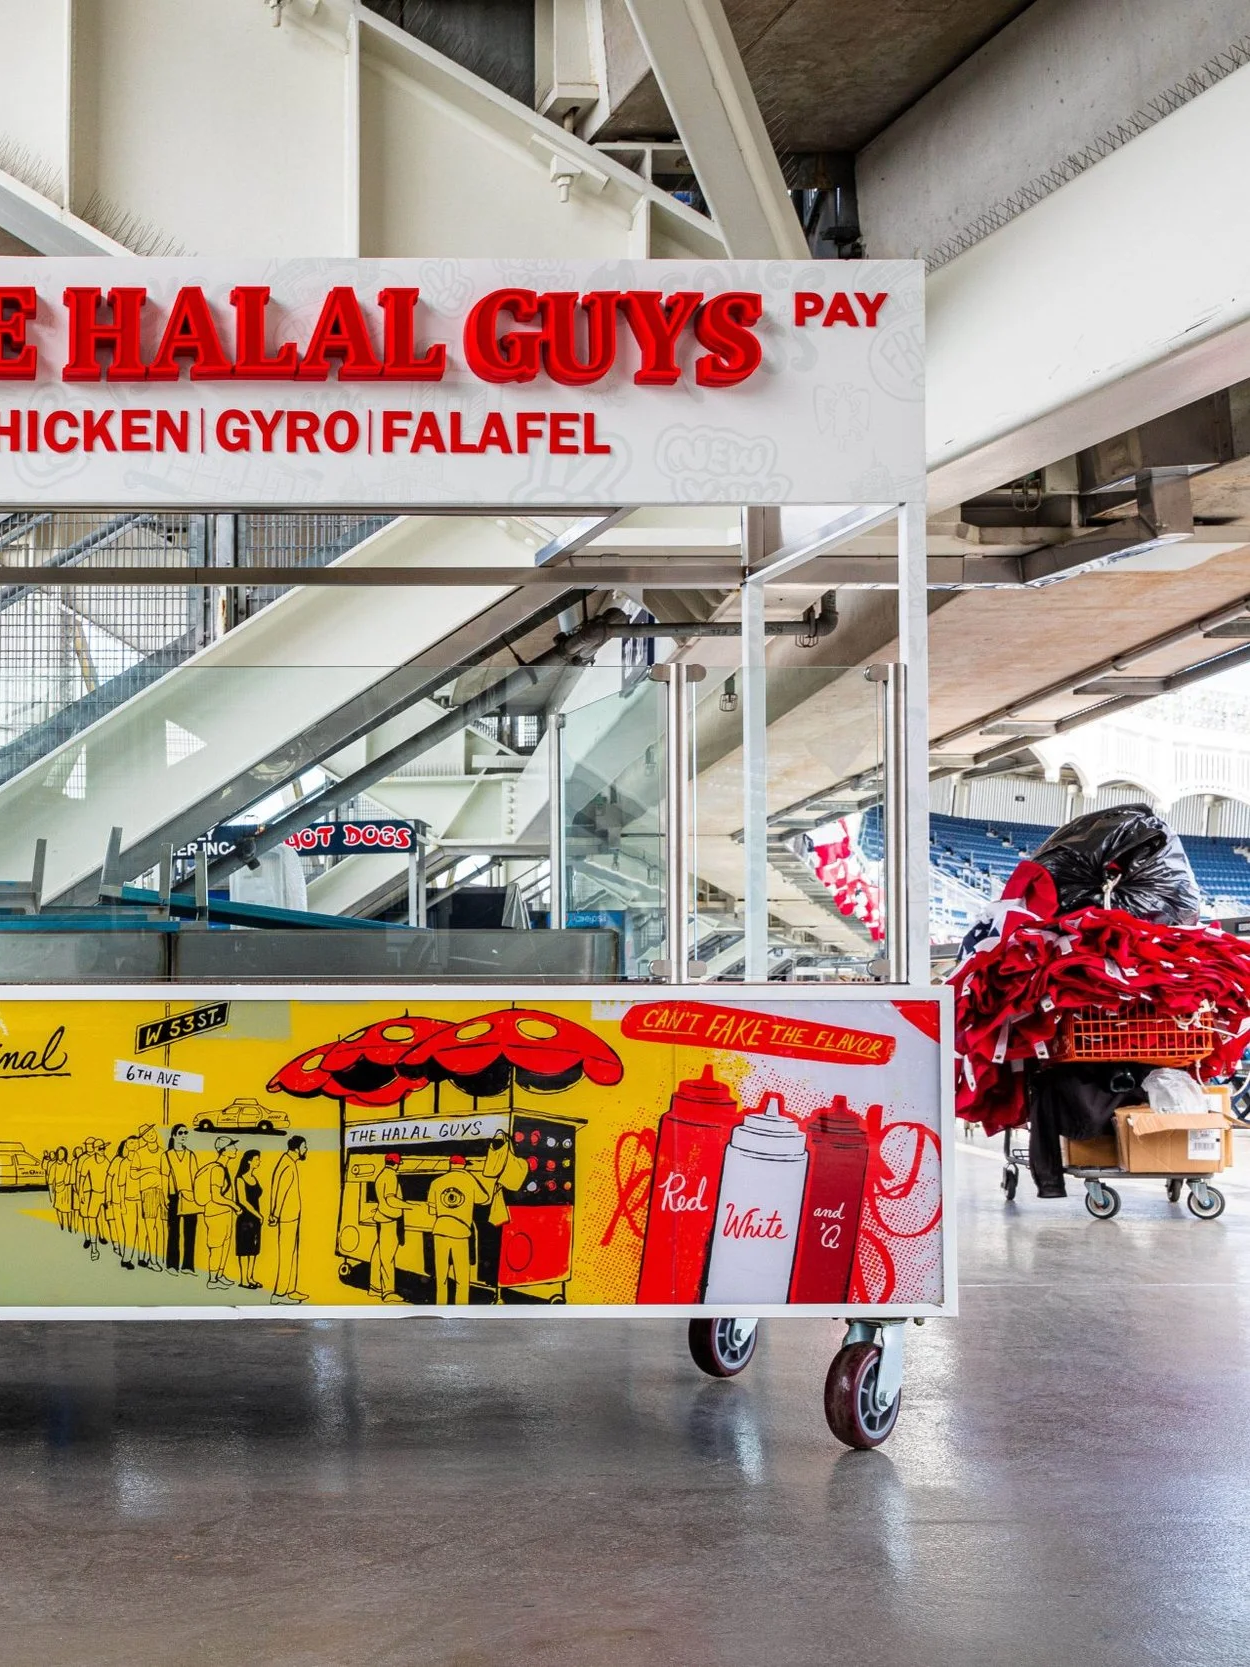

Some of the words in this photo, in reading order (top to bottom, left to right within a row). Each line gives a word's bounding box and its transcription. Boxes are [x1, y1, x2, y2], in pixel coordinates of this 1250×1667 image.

[795, 293, 888, 327] PAY
[62, 287, 446, 382] HALAL
[464, 289, 762, 387] GUYS
[216, 410, 360, 452] GYRO
[383, 411, 610, 454] FALAFEL
[343, 824, 411, 849] DOGS
[145, 1024, 163, 1046] W
[643, 1008, 704, 1031] CAN'T
[705, 1014, 769, 1047] FAKE
[770, 1024, 809, 1044] THE
[813, 1030, 884, 1056] FLAVOR
[126, 1064, 153, 1081] 6TH
[156, 1071, 181, 1087] AVE
[349, 1130, 377, 1142] THE
[381, 1126, 433, 1141] HALAL
[438, 1120, 483, 1138] GUYS
[658, 1171, 709, 1213] Red
[723, 1202, 789, 1240] White
[813, 1202, 846, 1220] and
